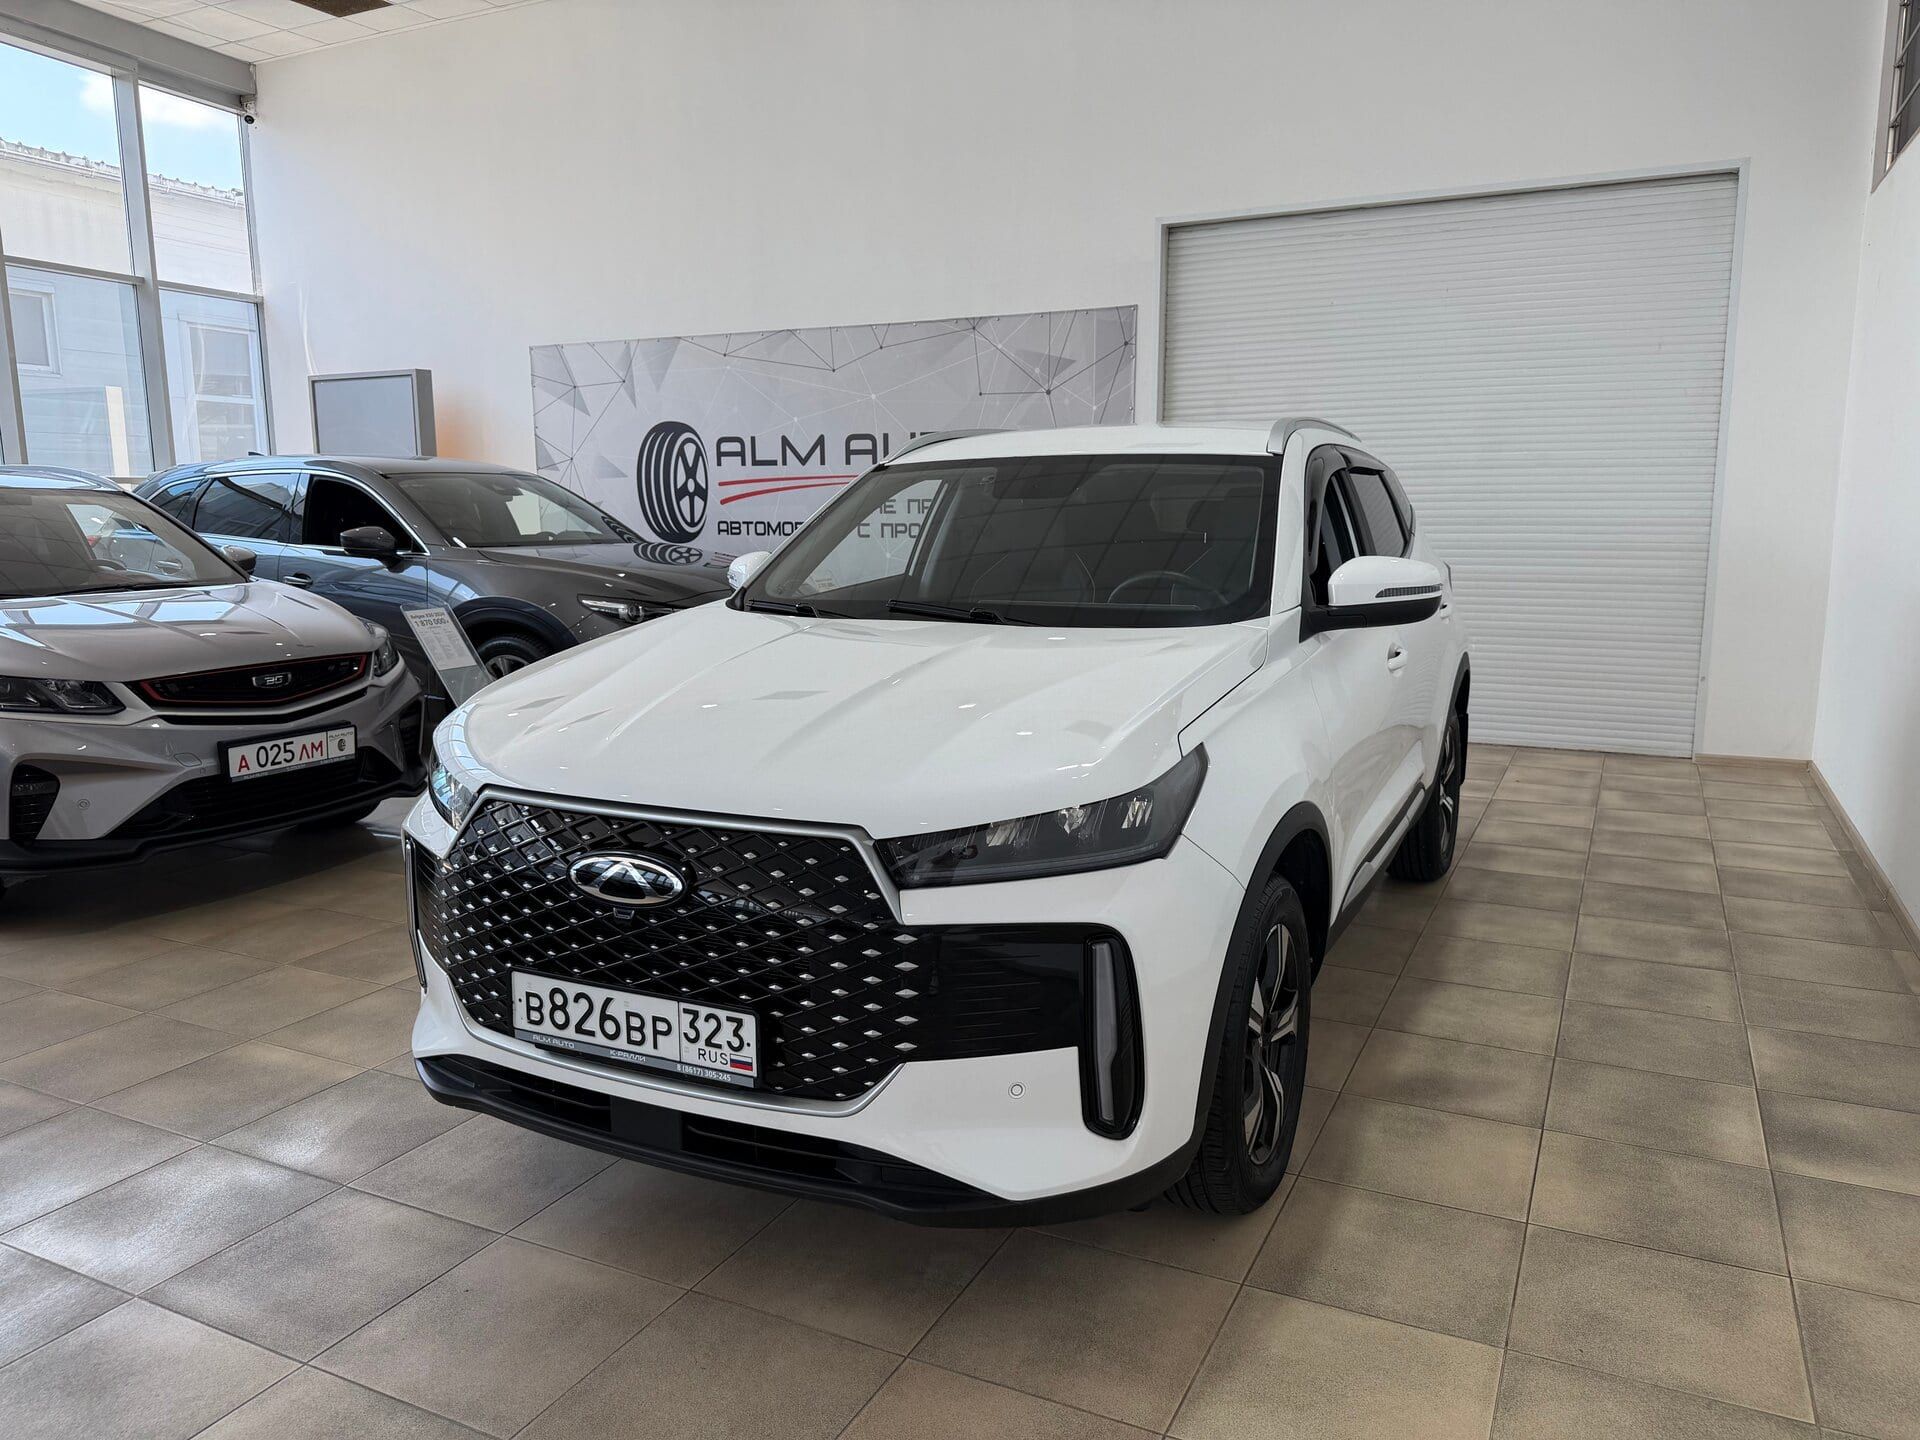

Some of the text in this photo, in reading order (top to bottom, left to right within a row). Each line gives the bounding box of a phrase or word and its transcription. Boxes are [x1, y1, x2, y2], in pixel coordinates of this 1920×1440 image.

[716, 434, 825, 467] ALM
[256, 740, 295, 768] 025
[532, 1034, 575, 1049] ALM AUTO
[682, 1008, 745, 1052] 323
[698, 1048, 729, 1066] RUS
[704, 1069, 731, 1082] 305-245
